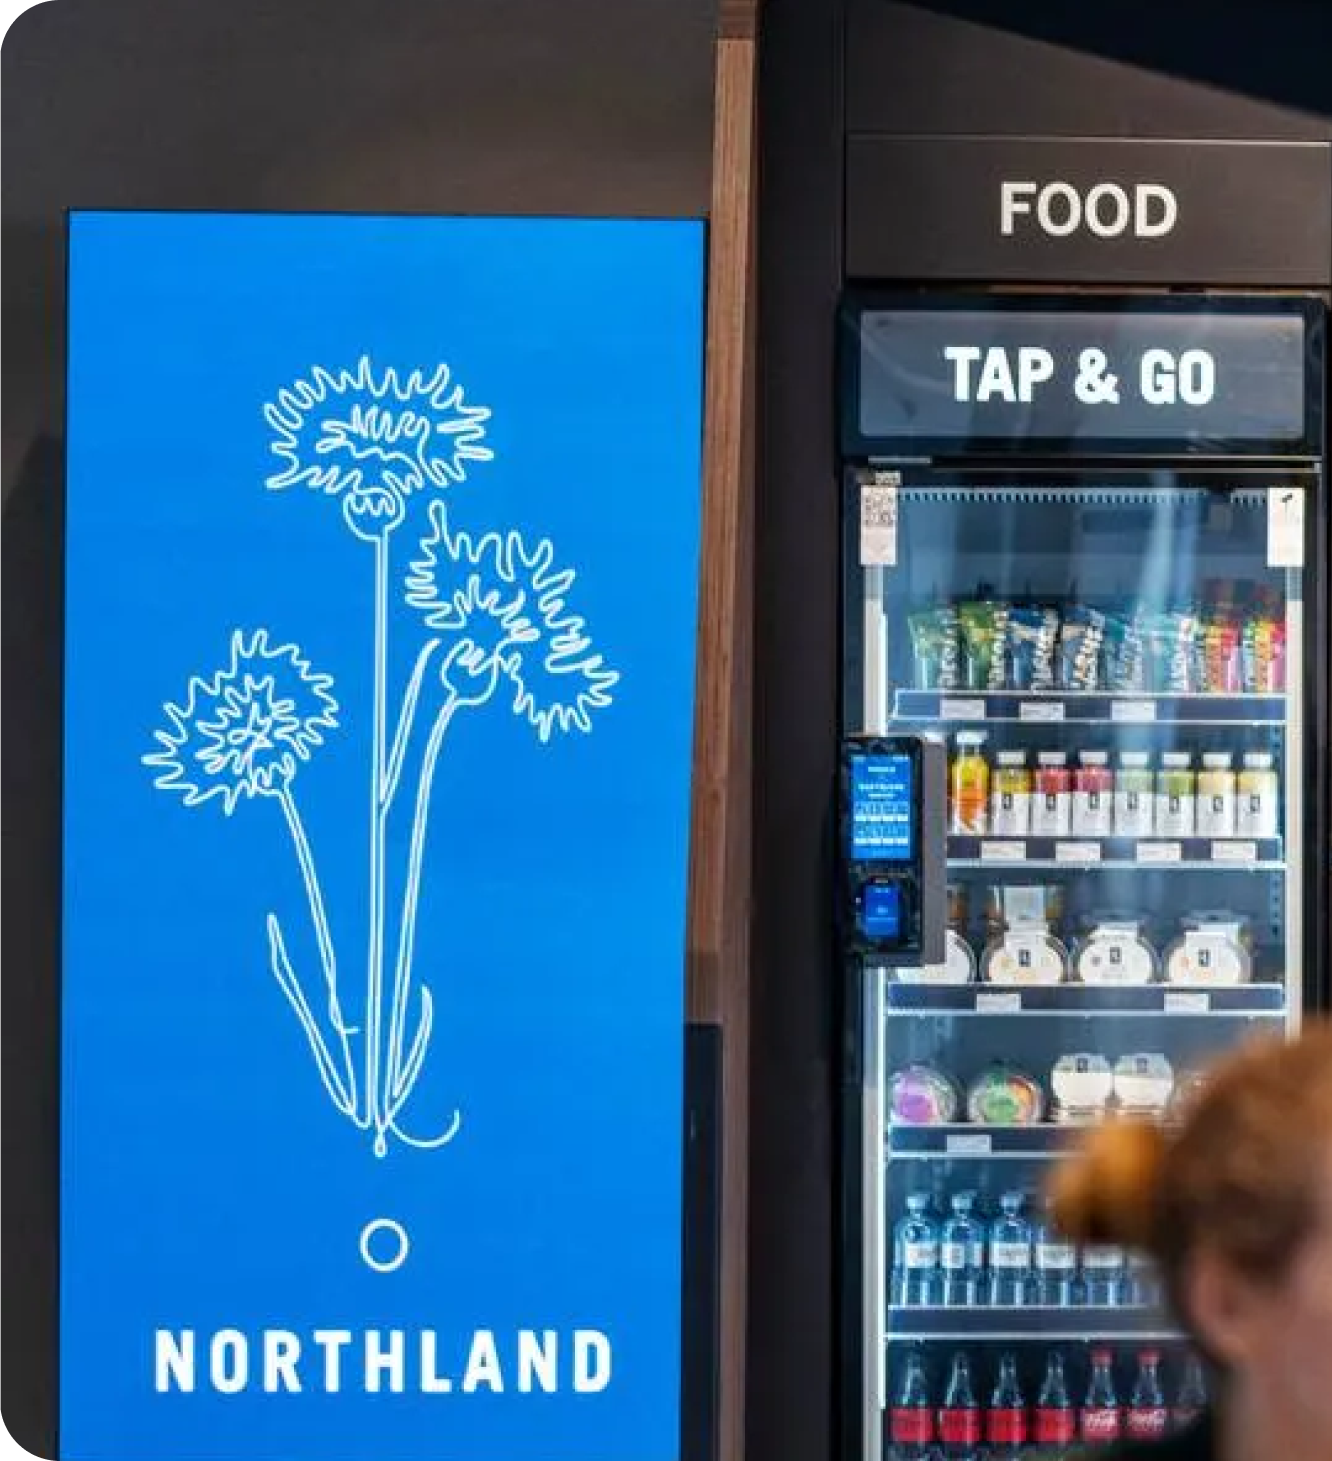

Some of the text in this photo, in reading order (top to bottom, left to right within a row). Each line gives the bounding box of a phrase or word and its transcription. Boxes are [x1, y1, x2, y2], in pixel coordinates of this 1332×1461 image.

[1001, 182, 1178, 237] FOOD
[945, 346, 1216, 405] TAP & GO
[155, 1329, 611, 1394] NORTHLAND
